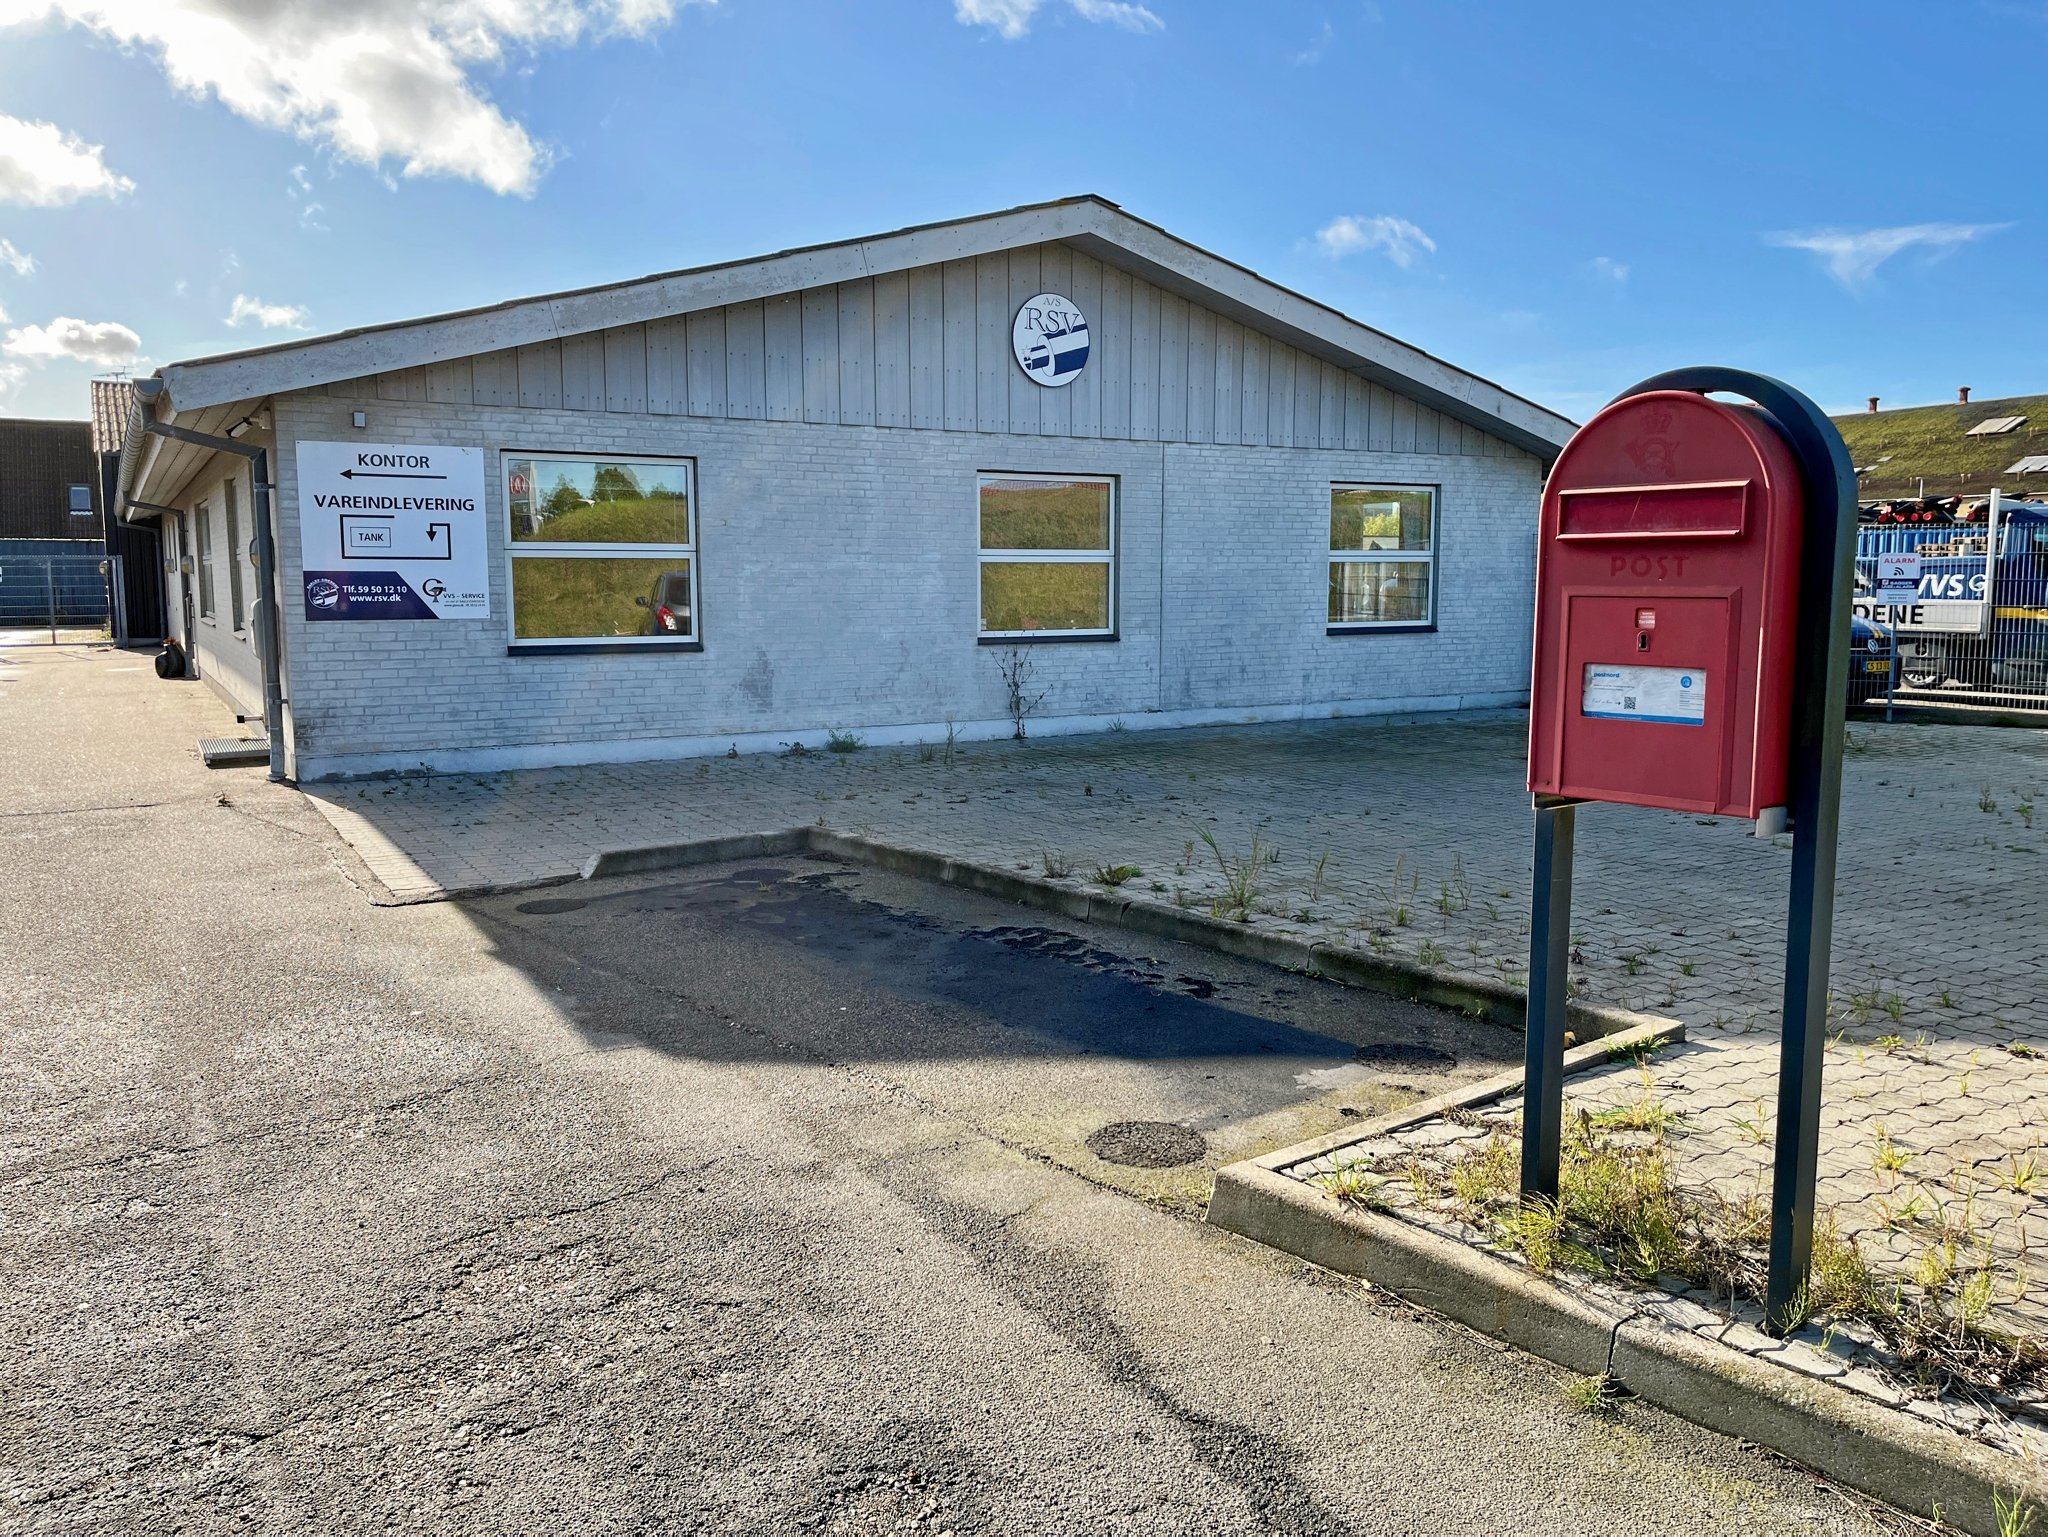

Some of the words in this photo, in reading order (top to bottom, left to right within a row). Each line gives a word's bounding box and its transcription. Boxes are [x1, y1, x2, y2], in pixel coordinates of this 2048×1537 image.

[1043, 297, 1062, 307] A/S
[1024, 306, 1080, 335] RSV
[358, 453, 430, 469] KONTOR
[313, 494, 475, 512] VAREINDLEVERING
[358, 532, 384, 542] TANK
[1610, 554, 1689, 581] POST
[342, 585, 357, 593] Tlf.
[358, 585, 369, 593] 59
[370, 585, 382, 593] 50
[384, 585, 395, 593] 12
[397, 585, 408, 593] 10
[349, 593, 402, 602] www.rsv.dk
